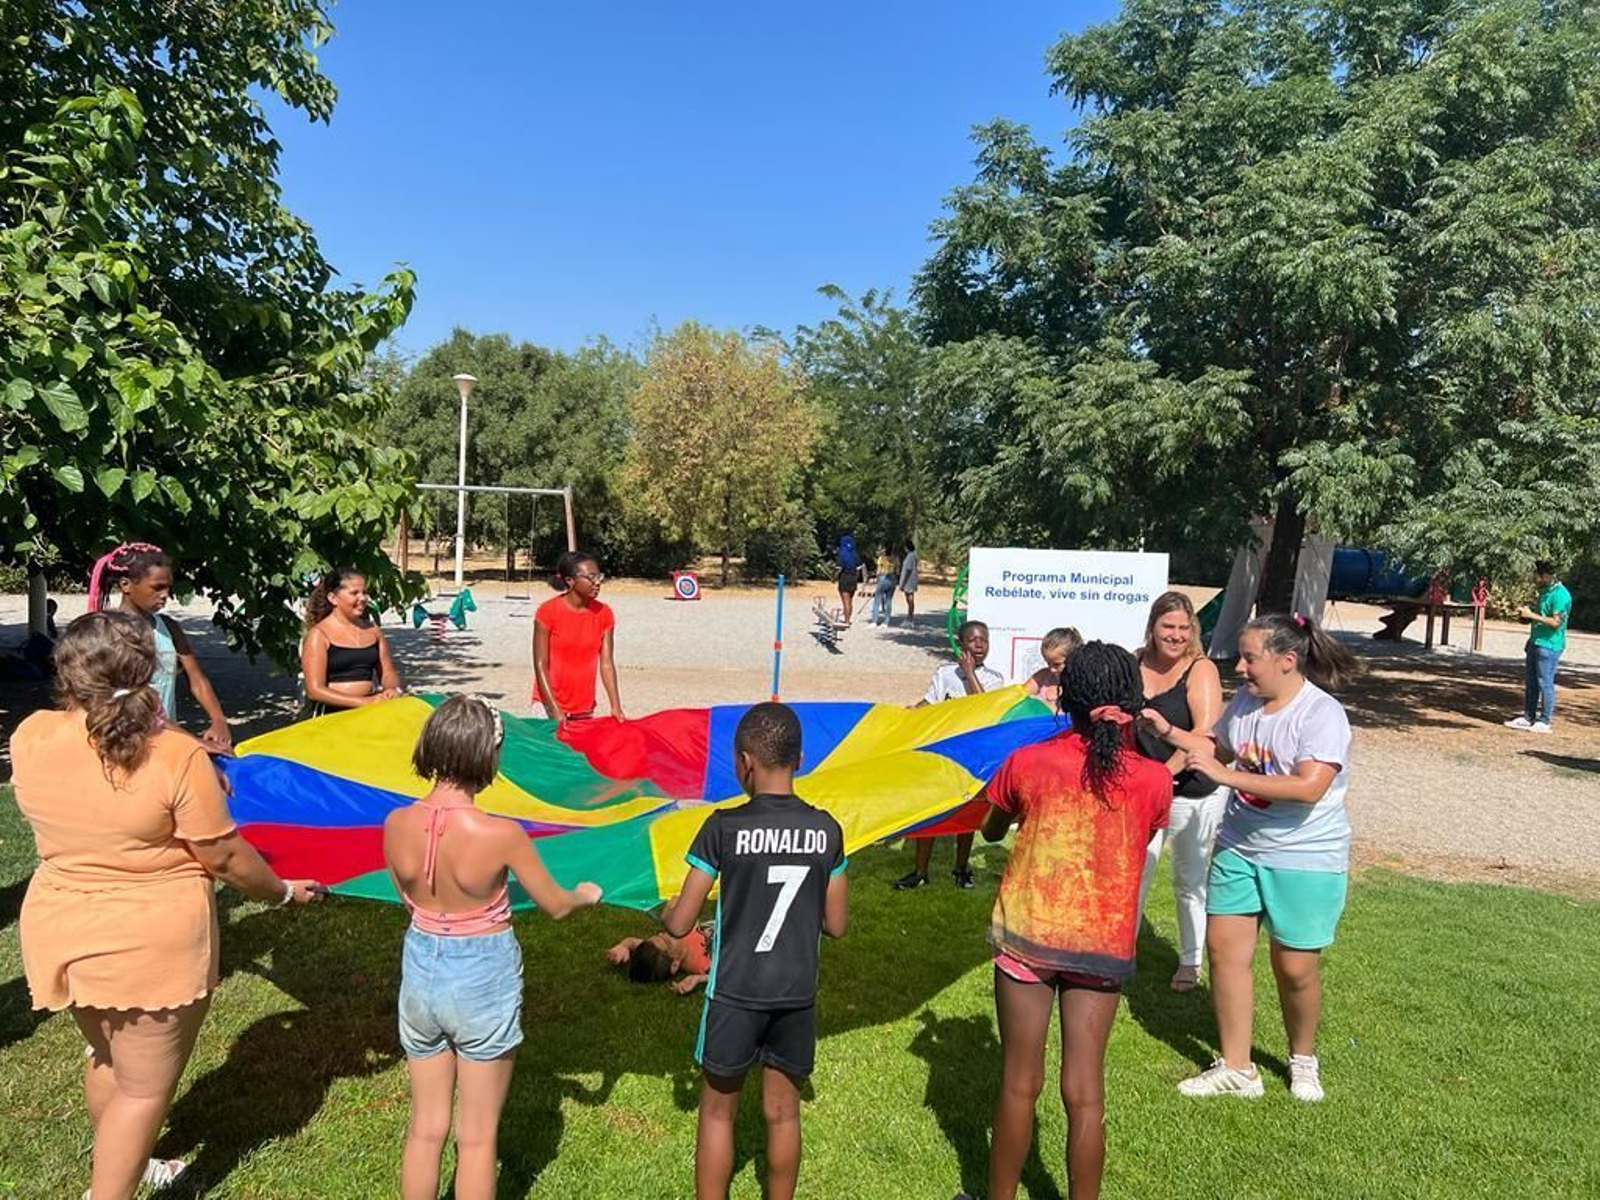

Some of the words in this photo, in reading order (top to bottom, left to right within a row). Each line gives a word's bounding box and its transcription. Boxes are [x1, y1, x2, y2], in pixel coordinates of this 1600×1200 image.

[1003, 571, 1066, 584] Programa
[1070, 573, 1134, 586] Municipal
[985, 586, 1046, 600] Rebélate,
[1050, 589, 1076, 600] vive
[1080, 590, 1100, 601] sin
[1104, 590, 1149, 605] drogas
[736, 829, 826, 855] RONALDO
[755, 866, 811, 952] 7
